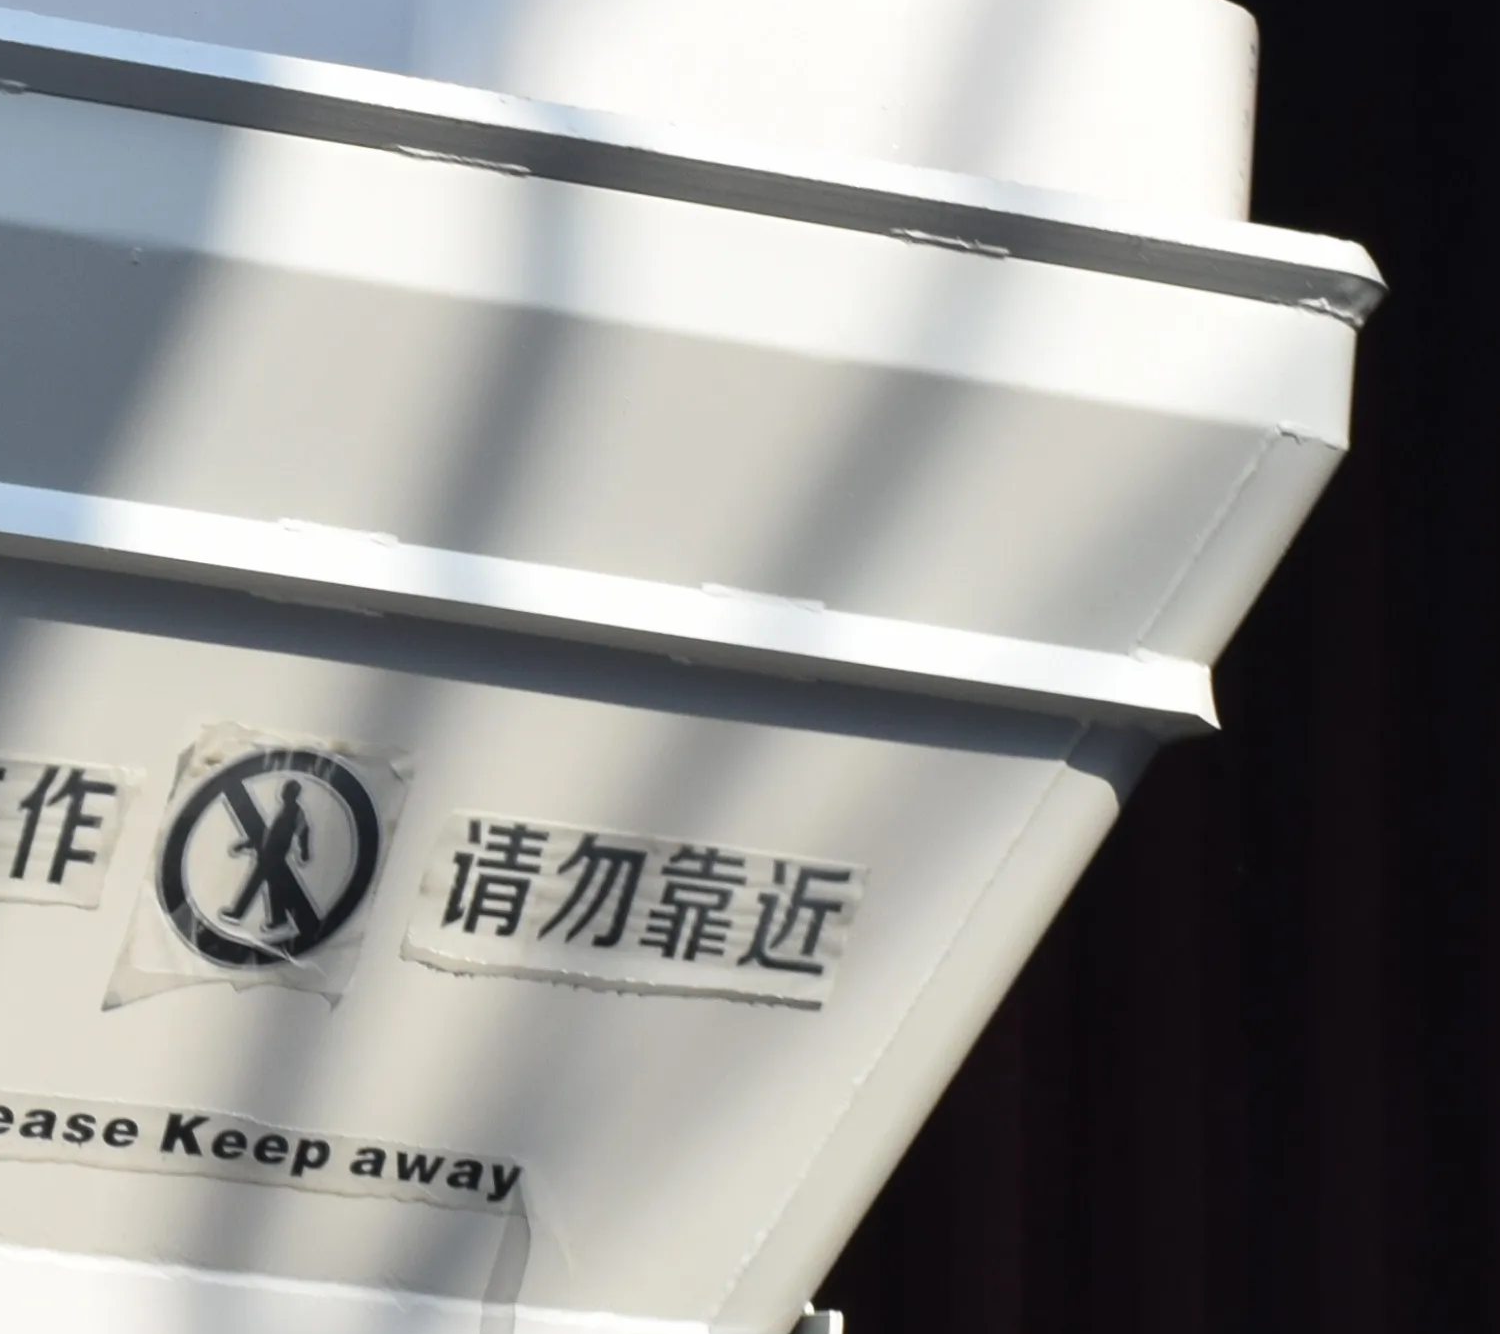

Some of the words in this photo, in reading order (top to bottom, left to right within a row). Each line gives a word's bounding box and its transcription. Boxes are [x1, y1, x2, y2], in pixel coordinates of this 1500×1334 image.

[440, 817, 854, 976] 请勿靠近
[160, 1112, 331, 1178] Keep
[349, 1147, 524, 1205] away
